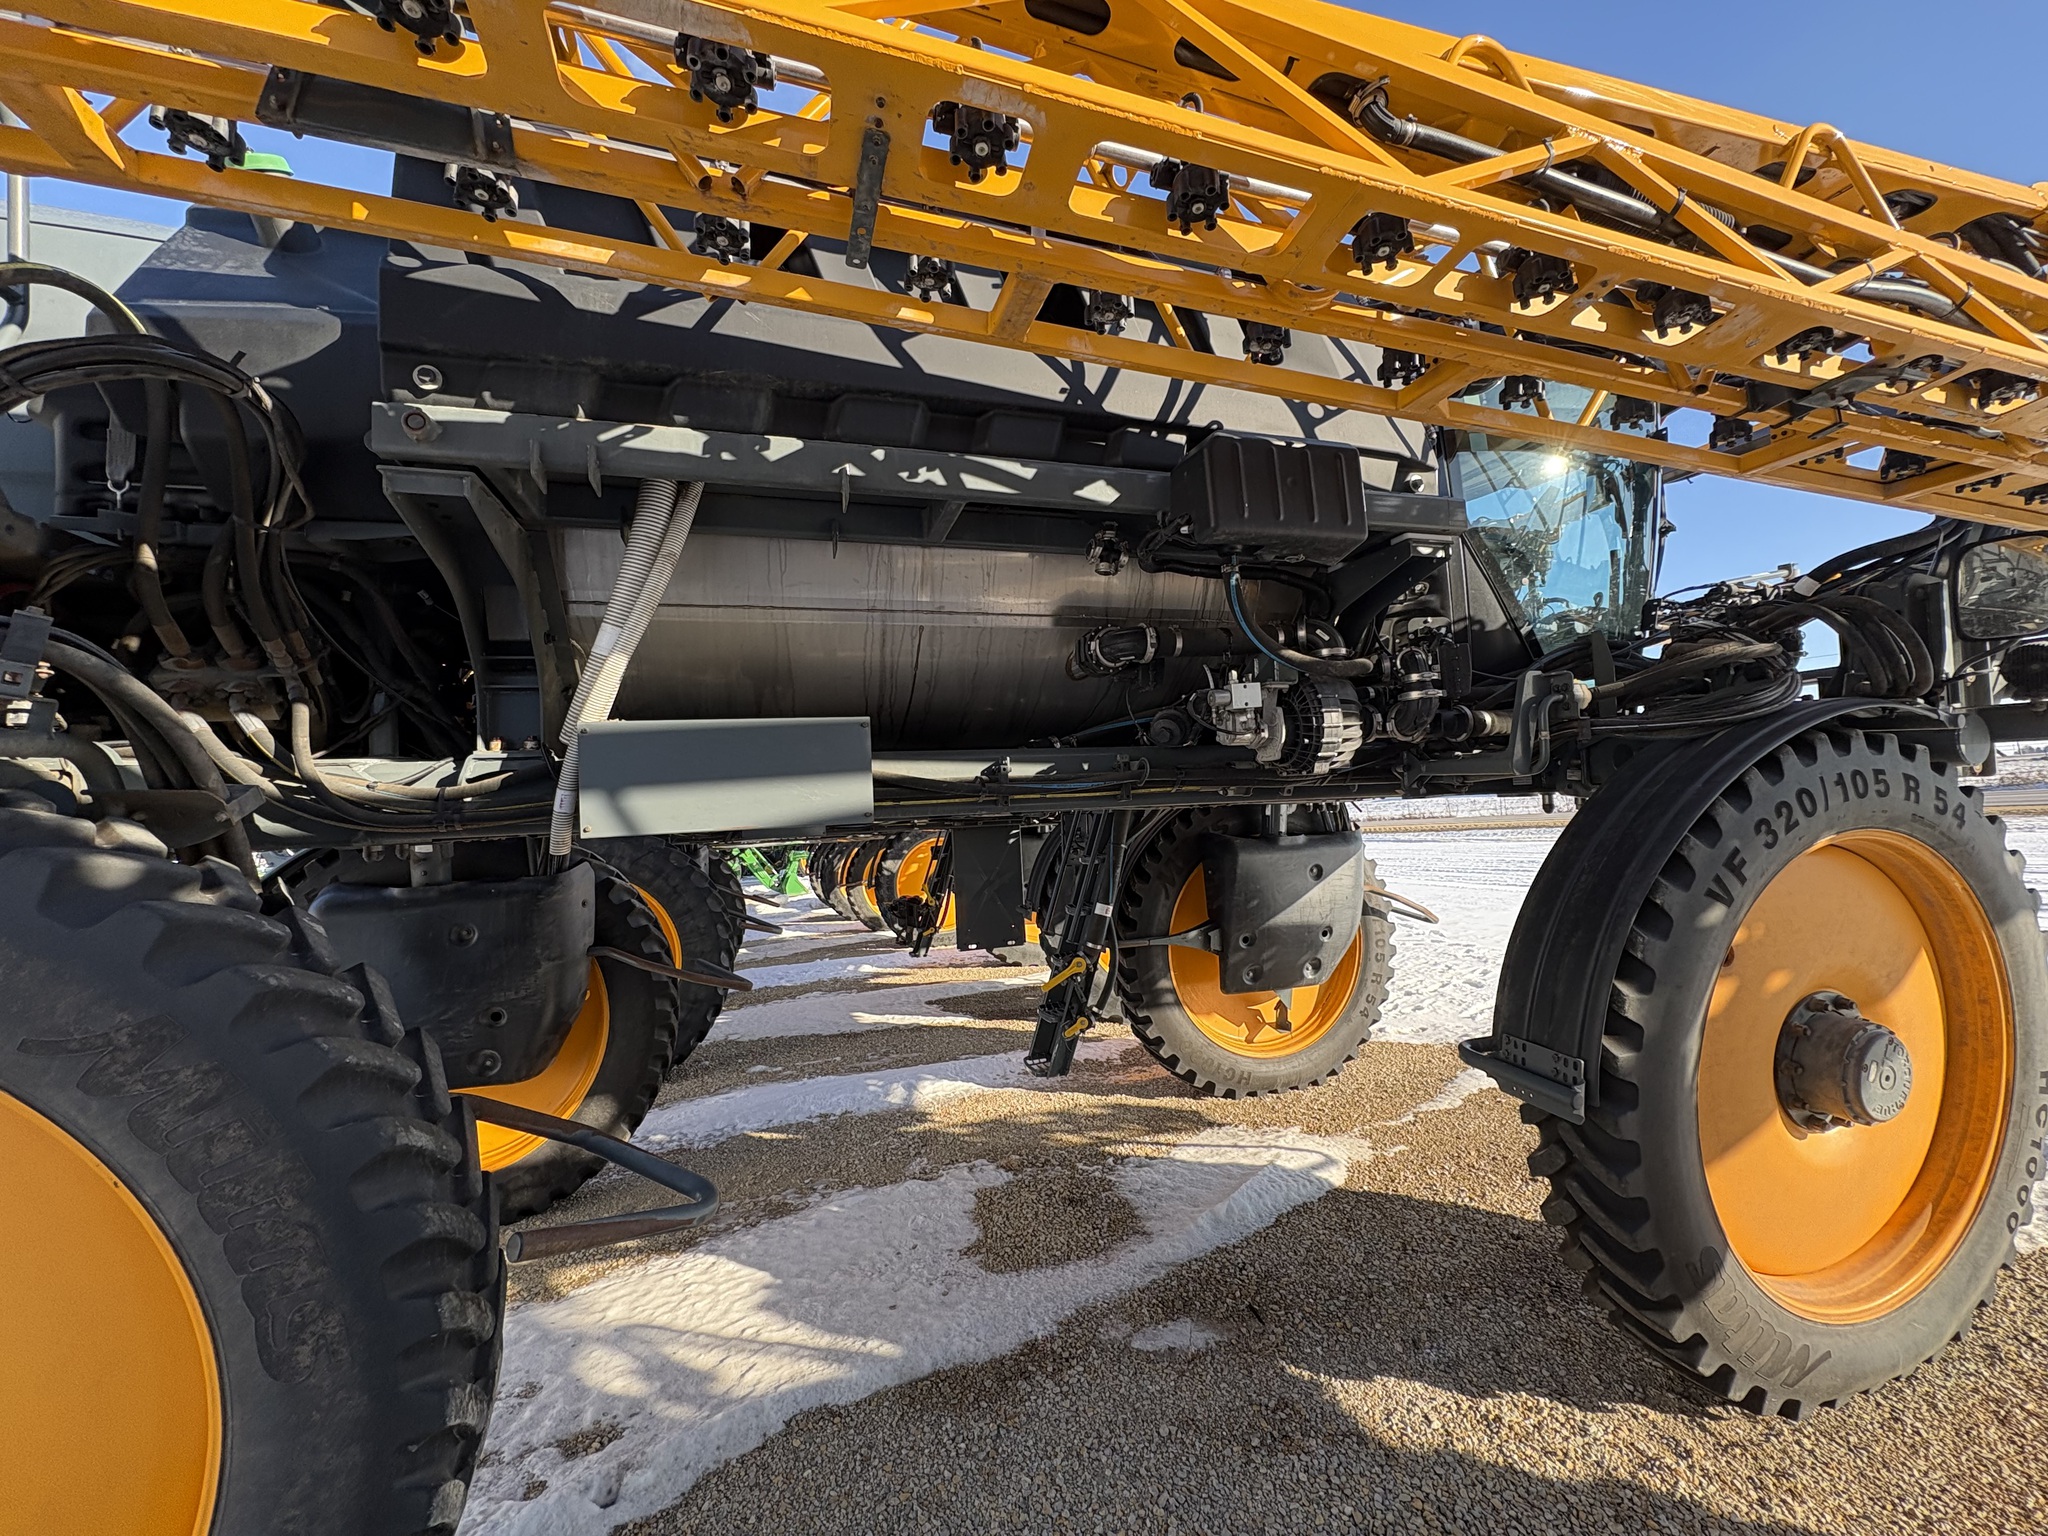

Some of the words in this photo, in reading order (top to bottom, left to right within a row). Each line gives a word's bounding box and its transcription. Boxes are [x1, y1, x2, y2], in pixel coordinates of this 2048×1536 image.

[1704, 846, 1747, 909] VF
[1753, 768, 1890, 850] 320/105
[1902, 772, 1920, 804] R
[1933, 785, 1966, 830] 54
